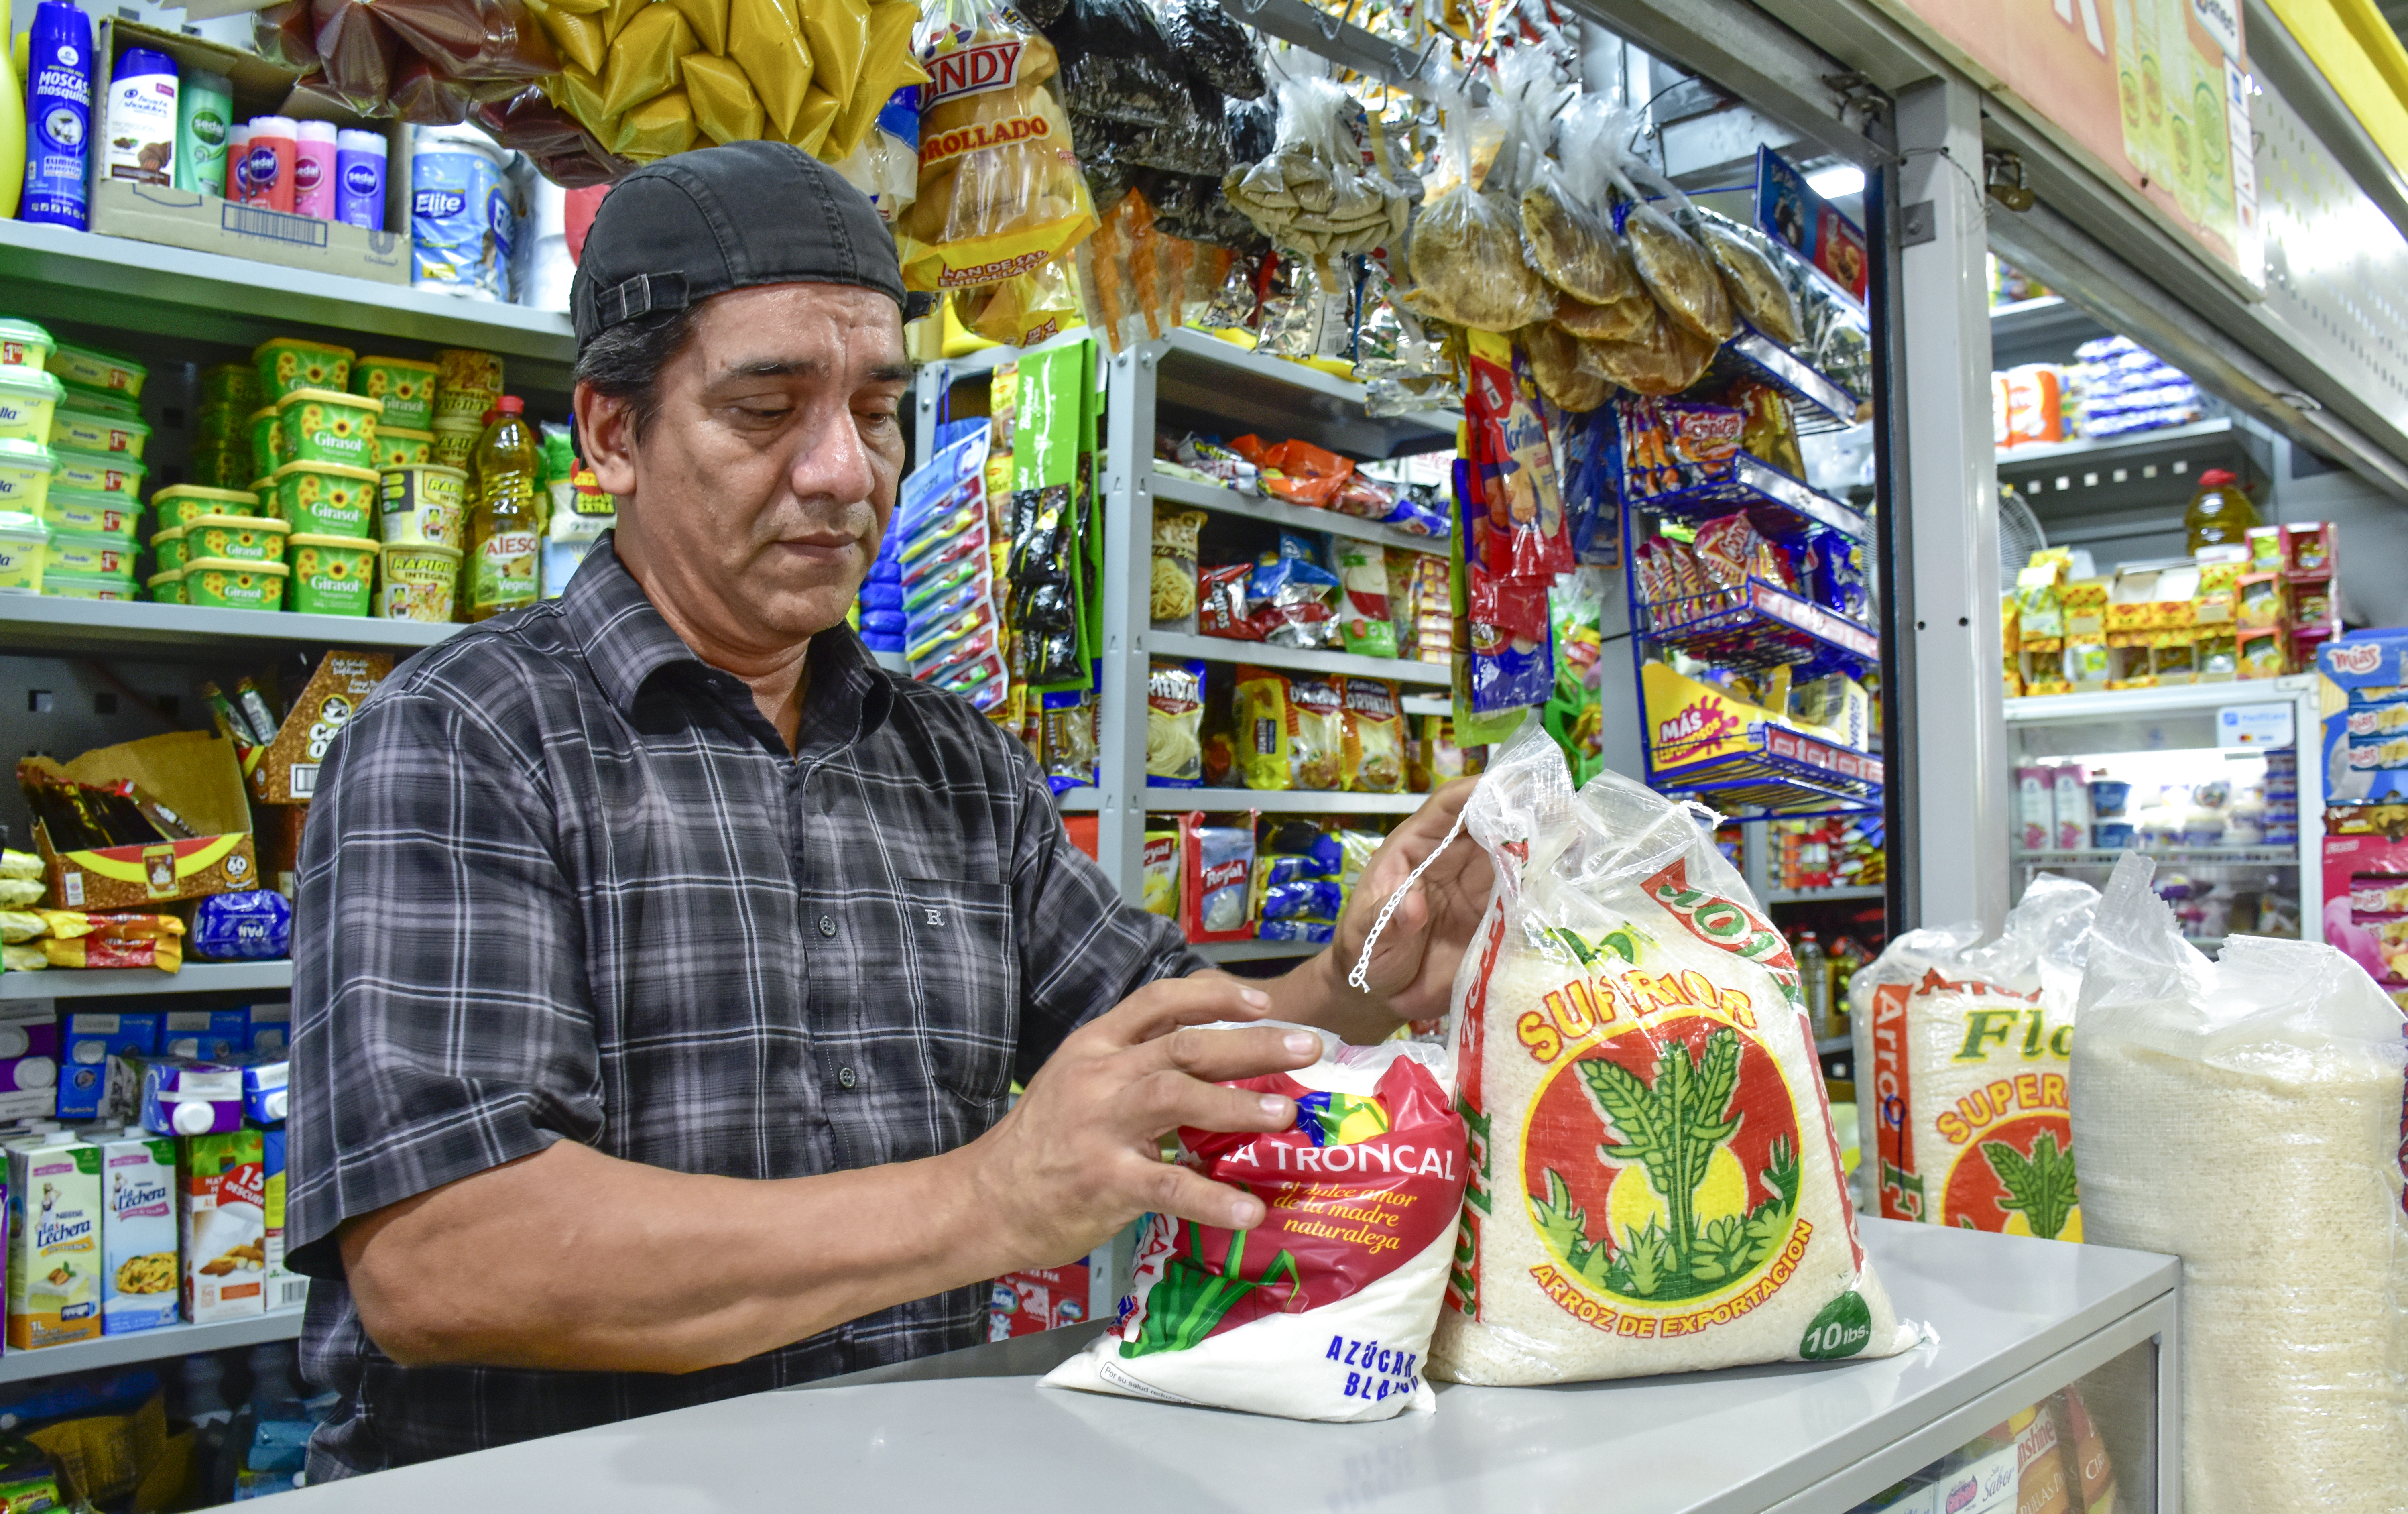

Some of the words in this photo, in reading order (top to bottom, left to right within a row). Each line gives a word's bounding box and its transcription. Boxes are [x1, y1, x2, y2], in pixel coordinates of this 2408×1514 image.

[39, 71, 89, 94] MOSCAS
[918, 42, 1021, 108] ANDY
[194, 119, 224, 137] sedal
[251, 156, 275, 169] sedal
[348, 173, 376, 186] sedal
[416, 193, 460, 213] Elite
[988, 259, 1013, 274] DE
[1016, 250, 1048, 268] SAL
[315, 431, 361, 452] Girasol
[312, 503, 358, 522] Girasol
[226, 543, 262, 556] Girasol
[225, 586, 260, 598] Girasol
[311, 576, 358, 593] Girasol
[1662, 711, 1703, 742] MÁS
[227, 856, 247, 873] 60
[1206, 863, 1243, 888] Royal
[1462, 907, 1503, 1054] rroz
[1517, 969, 1757, 1065] SUPRIOR
[1271, 1141, 1455, 1181] TRONCAL
[118, 1187, 167, 1211] Lechera
[1303, 1182, 1358, 1198] dulce
[1360, 1190, 1417, 1208] amor
[1274, 1195, 1300, 1209] de
[1303, 1198, 1324, 1215] la
[1329, 1202, 1399, 1227] madre
[37, 1218, 91, 1249] Lechera
[1283, 1219, 1401, 1254] naturaleza
[1529, 1263, 1619, 1332] ARROZ
[1617, 1314, 1658, 1339] DE
[1660, 1218, 1814, 1339] EXPORTACION
[1806, 1322, 1843, 1352] 10
[1326, 1335, 1416, 1378] AZÚCAR
[1105, 1366, 1117, 1379] Por
[1118, 1375, 1126, 1384] su
[1128, 1379, 1149, 1393] salud
[1982, 1465, 2015, 1502] Sabor
